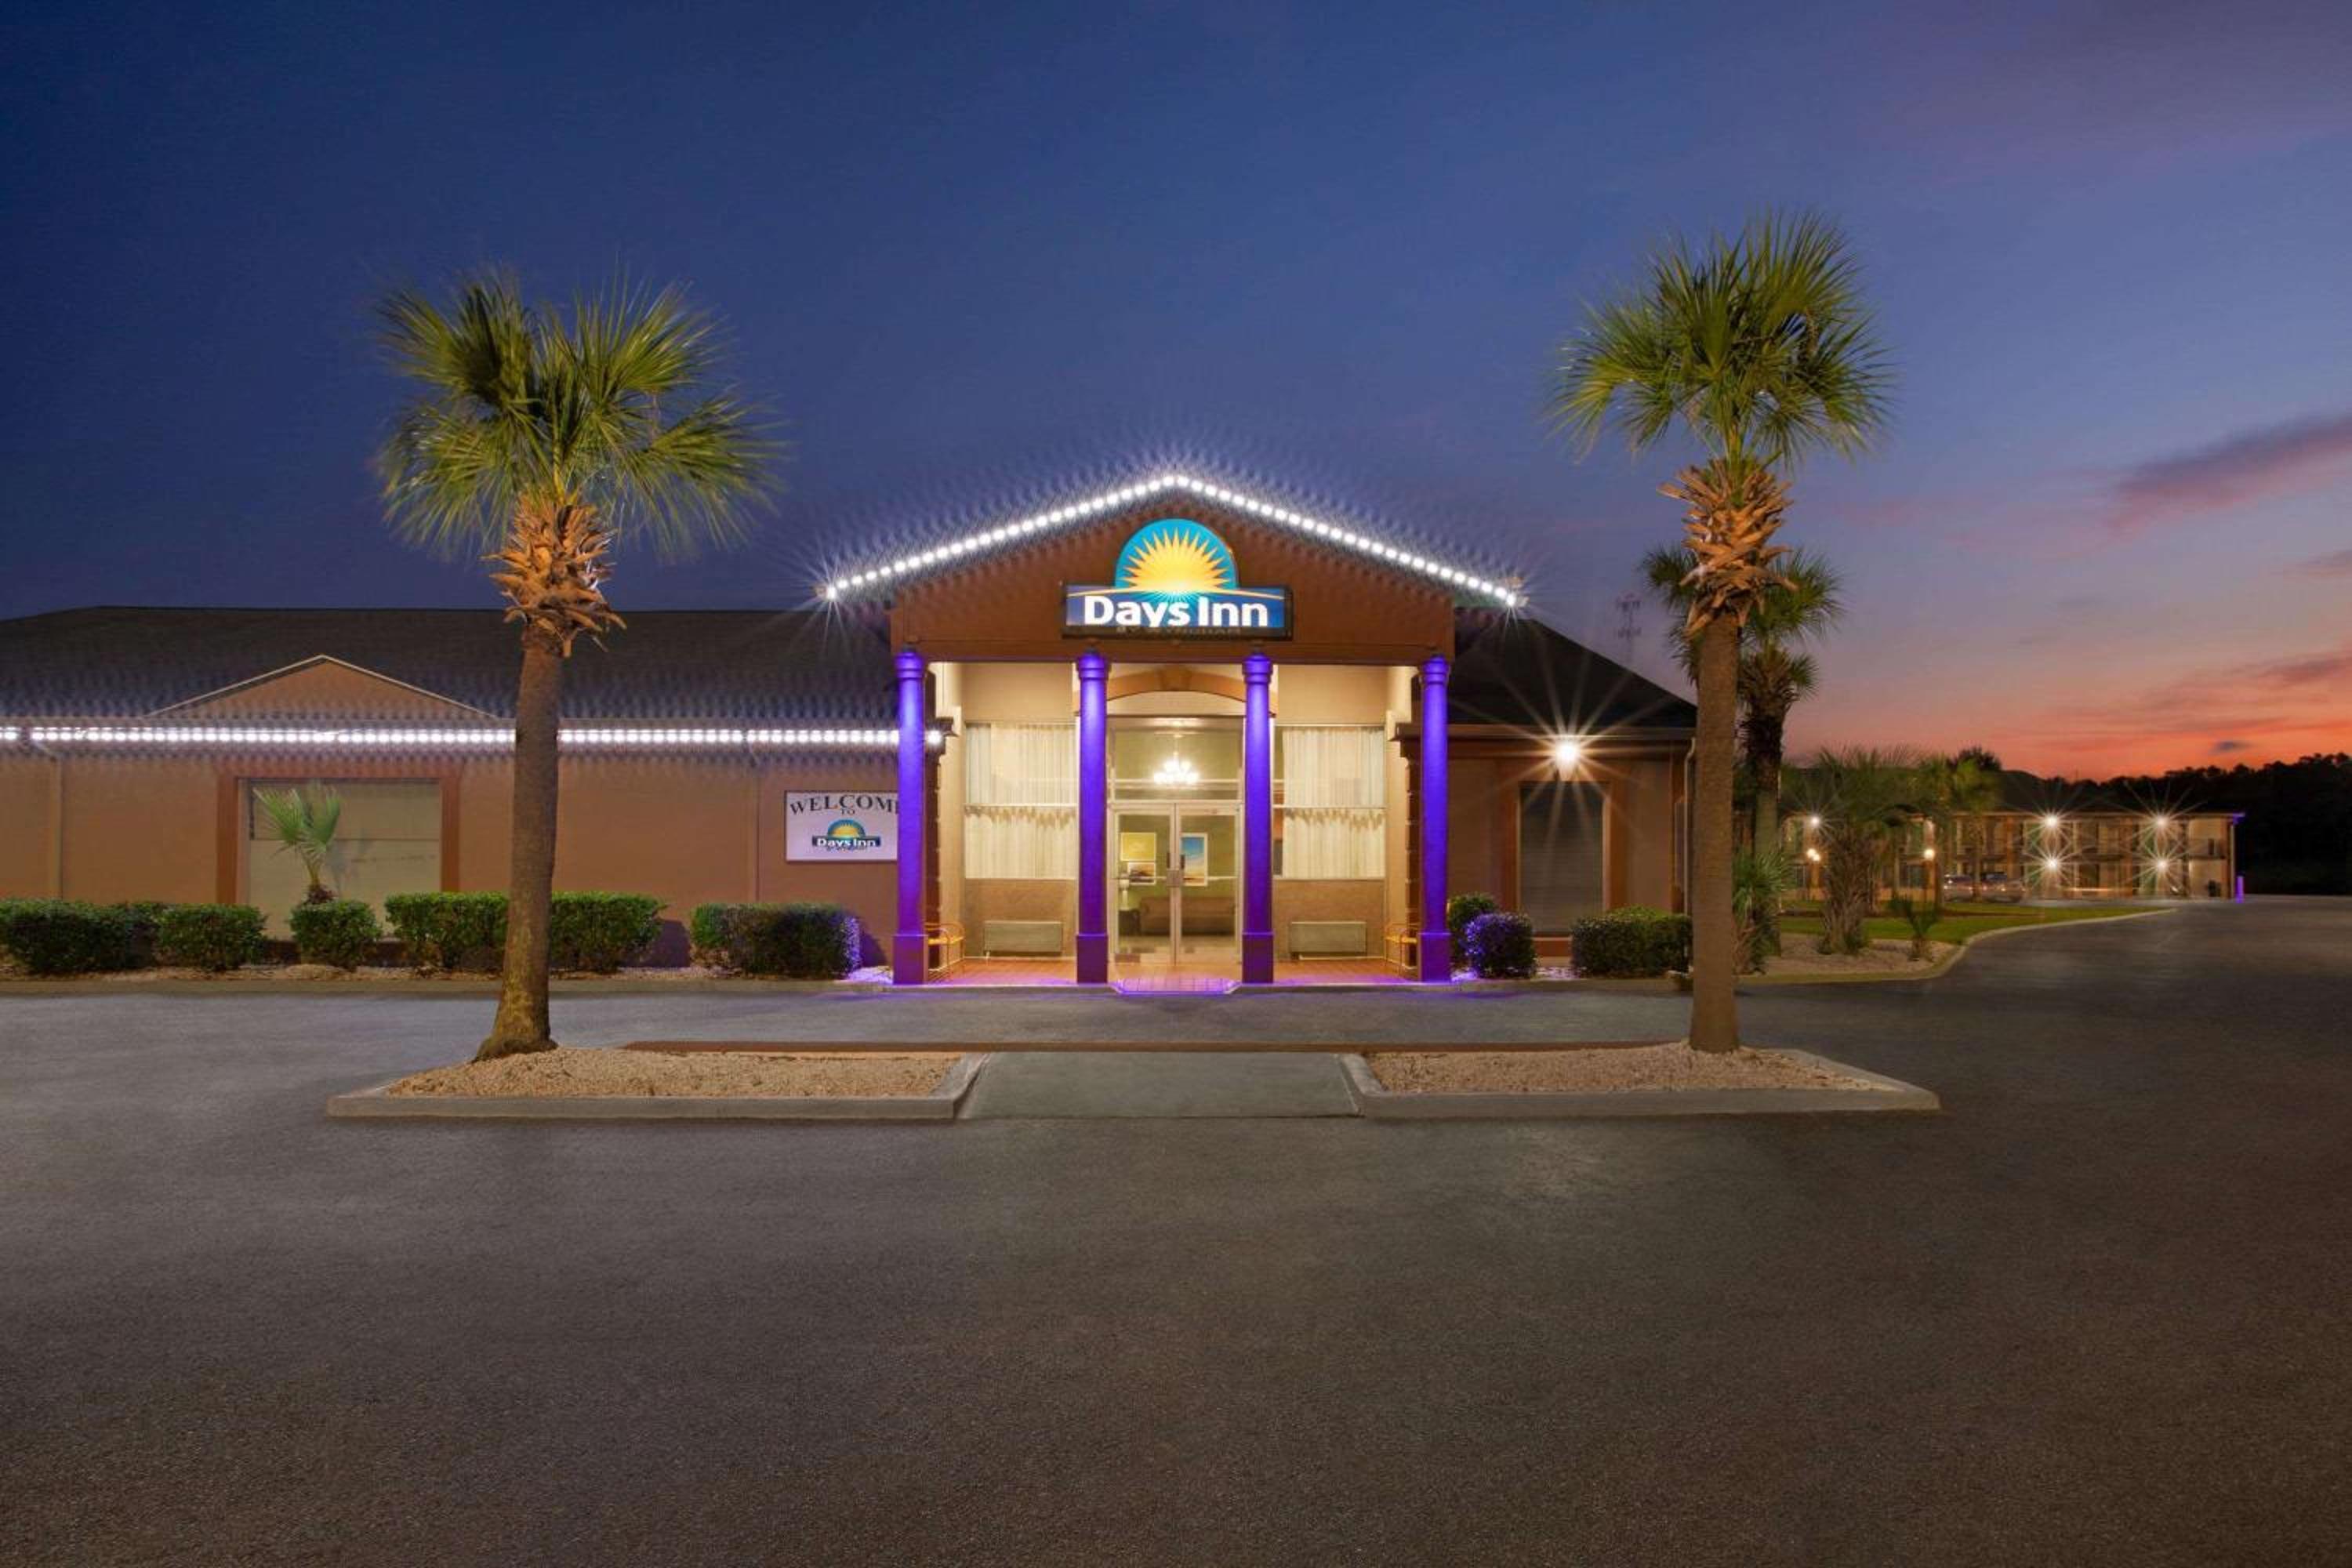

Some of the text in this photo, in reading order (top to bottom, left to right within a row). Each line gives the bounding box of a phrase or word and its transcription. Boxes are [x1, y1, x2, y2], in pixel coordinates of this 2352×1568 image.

[1083, 595, 1269, 628] Days Inn
[817, 837, 876, 848] Days Inn
